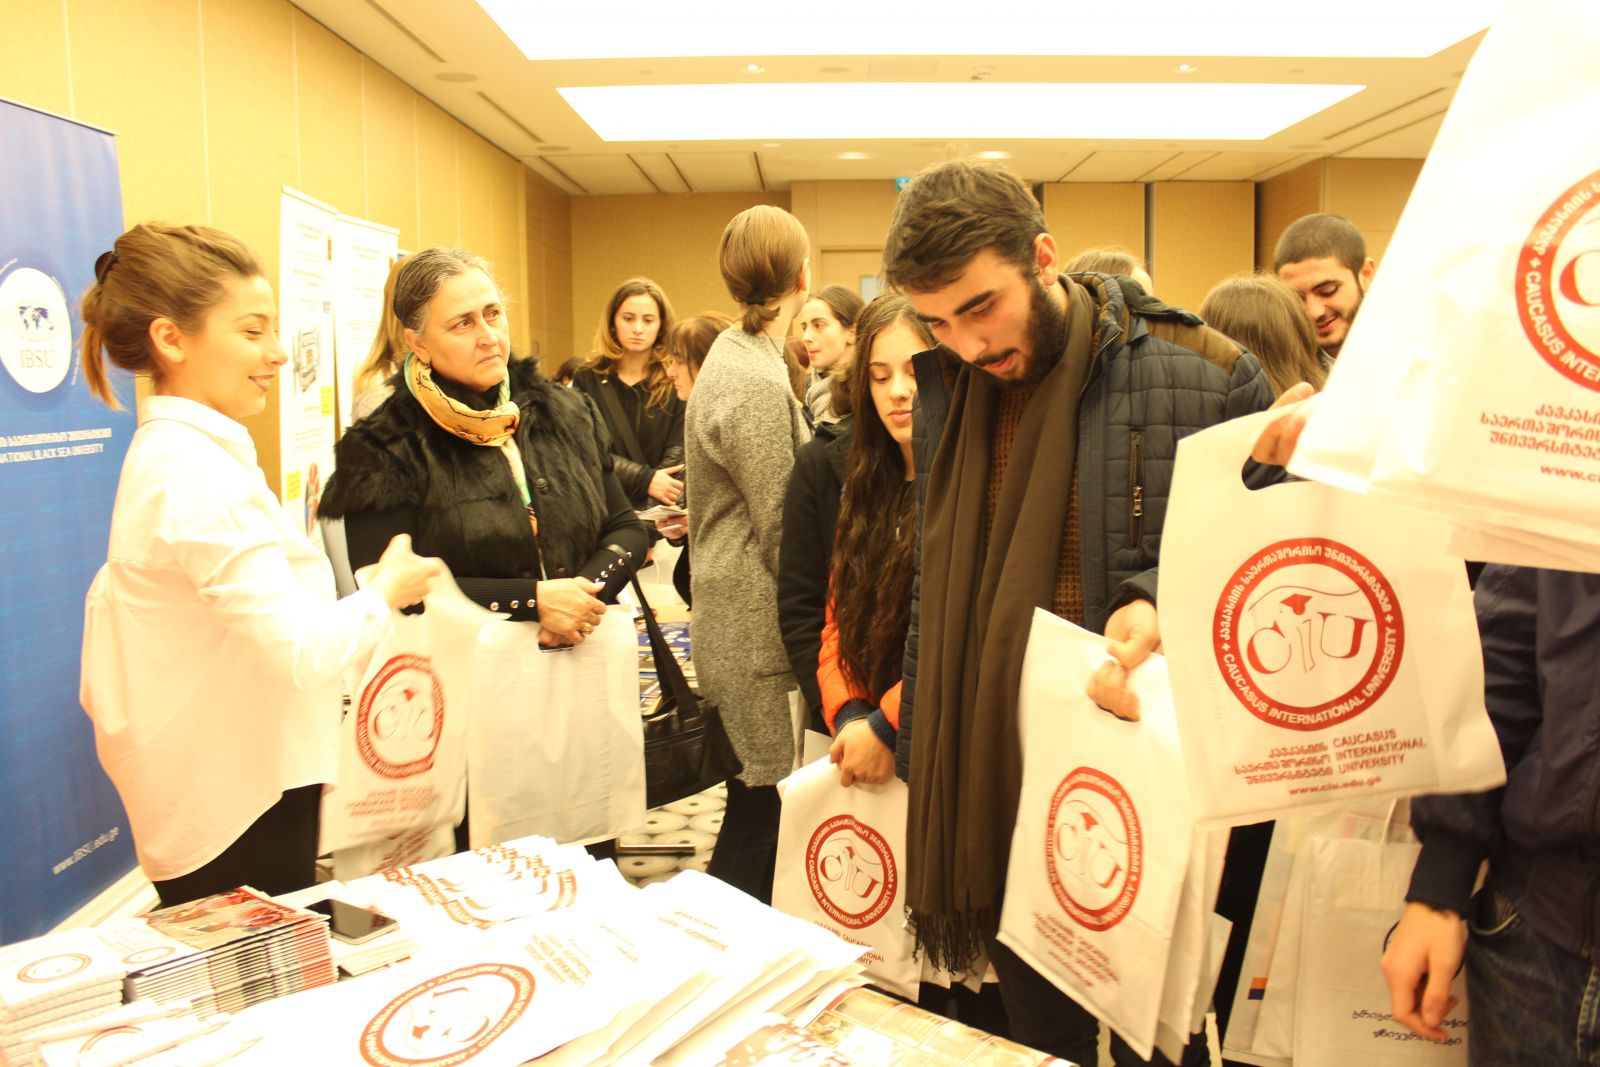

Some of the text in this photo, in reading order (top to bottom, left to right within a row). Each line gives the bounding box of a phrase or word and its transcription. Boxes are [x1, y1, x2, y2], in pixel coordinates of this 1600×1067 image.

[1525, 270, 1565, 357] CAUCASUS
[19, 349, 56, 369] IBSU
[1223, 654, 1270, 714] CAUCASUS
[1268, 697, 1366, 725] INTERNATIONAL
[1363, 628, 1397, 697] UNIVERSITY
[1332, 728, 1397, 749] CAUCASUS
[1336, 737, 1426, 761] INTERNATIONAL
[1338, 752, 1406, 775] UNIVERSITY
[1288, 775, 1383, 796] www.ciu.edu.ge
[808, 860, 892, 925] CAUCASUS INTERNATIONAL UNIVERSITY
